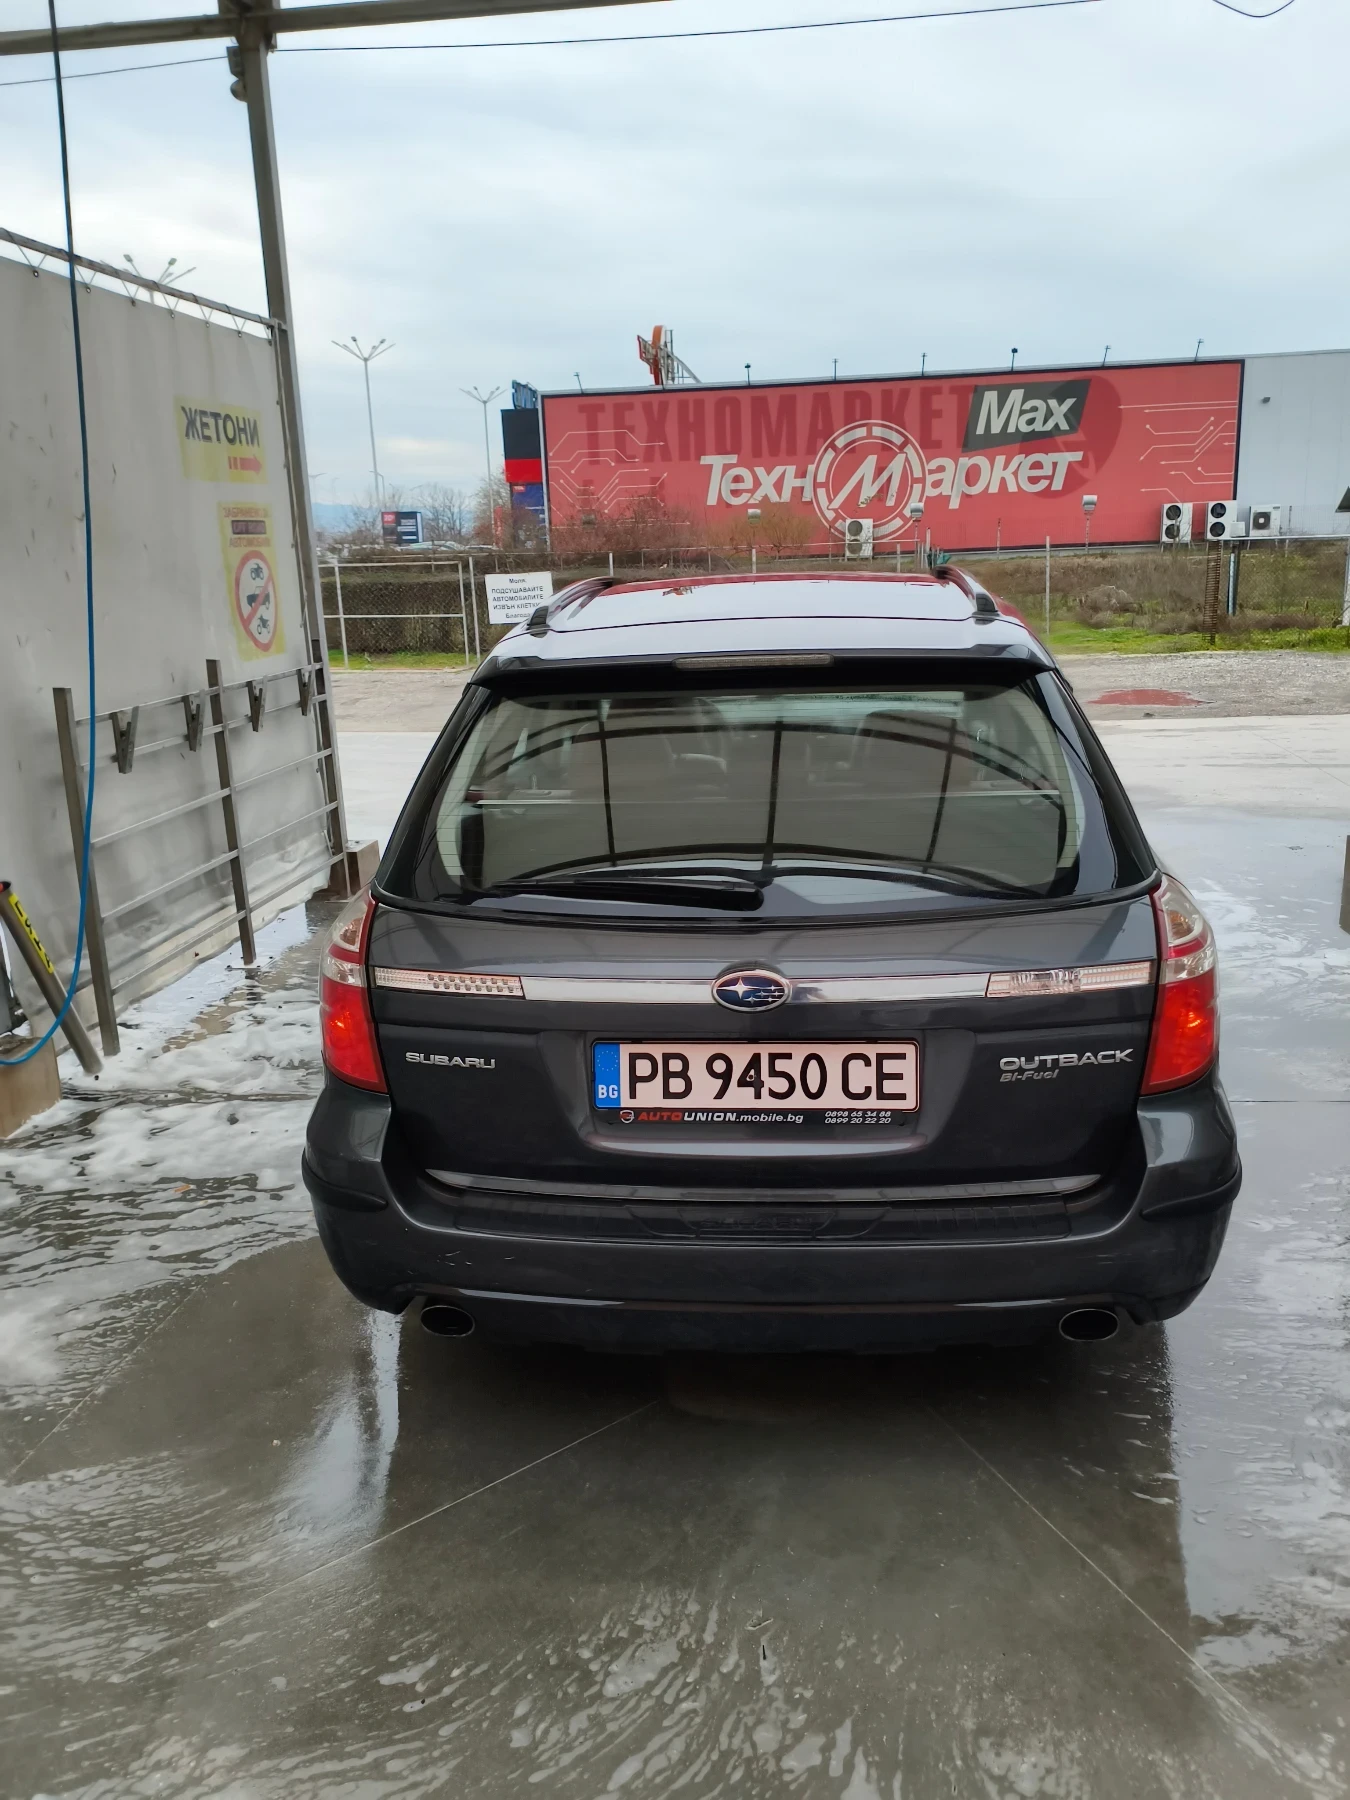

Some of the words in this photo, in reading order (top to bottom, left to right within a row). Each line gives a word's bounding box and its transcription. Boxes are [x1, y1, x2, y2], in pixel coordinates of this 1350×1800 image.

[975, 388, 1077, 435] Max
[181, 405, 261, 448] ЖЕТОНИ
[493, 594, 544, 602] АВТОМОБИЛИТЕ
[405, 1052, 496, 1069] SUBARU
[1000, 1048, 1134, 1070] OUTBACK
[628, 1052, 693, 1100] PB
[705, 1052, 828, 1101] 9450
[841, 1052, 907, 1101] CE
[597, 1084, 619, 1099] BG
